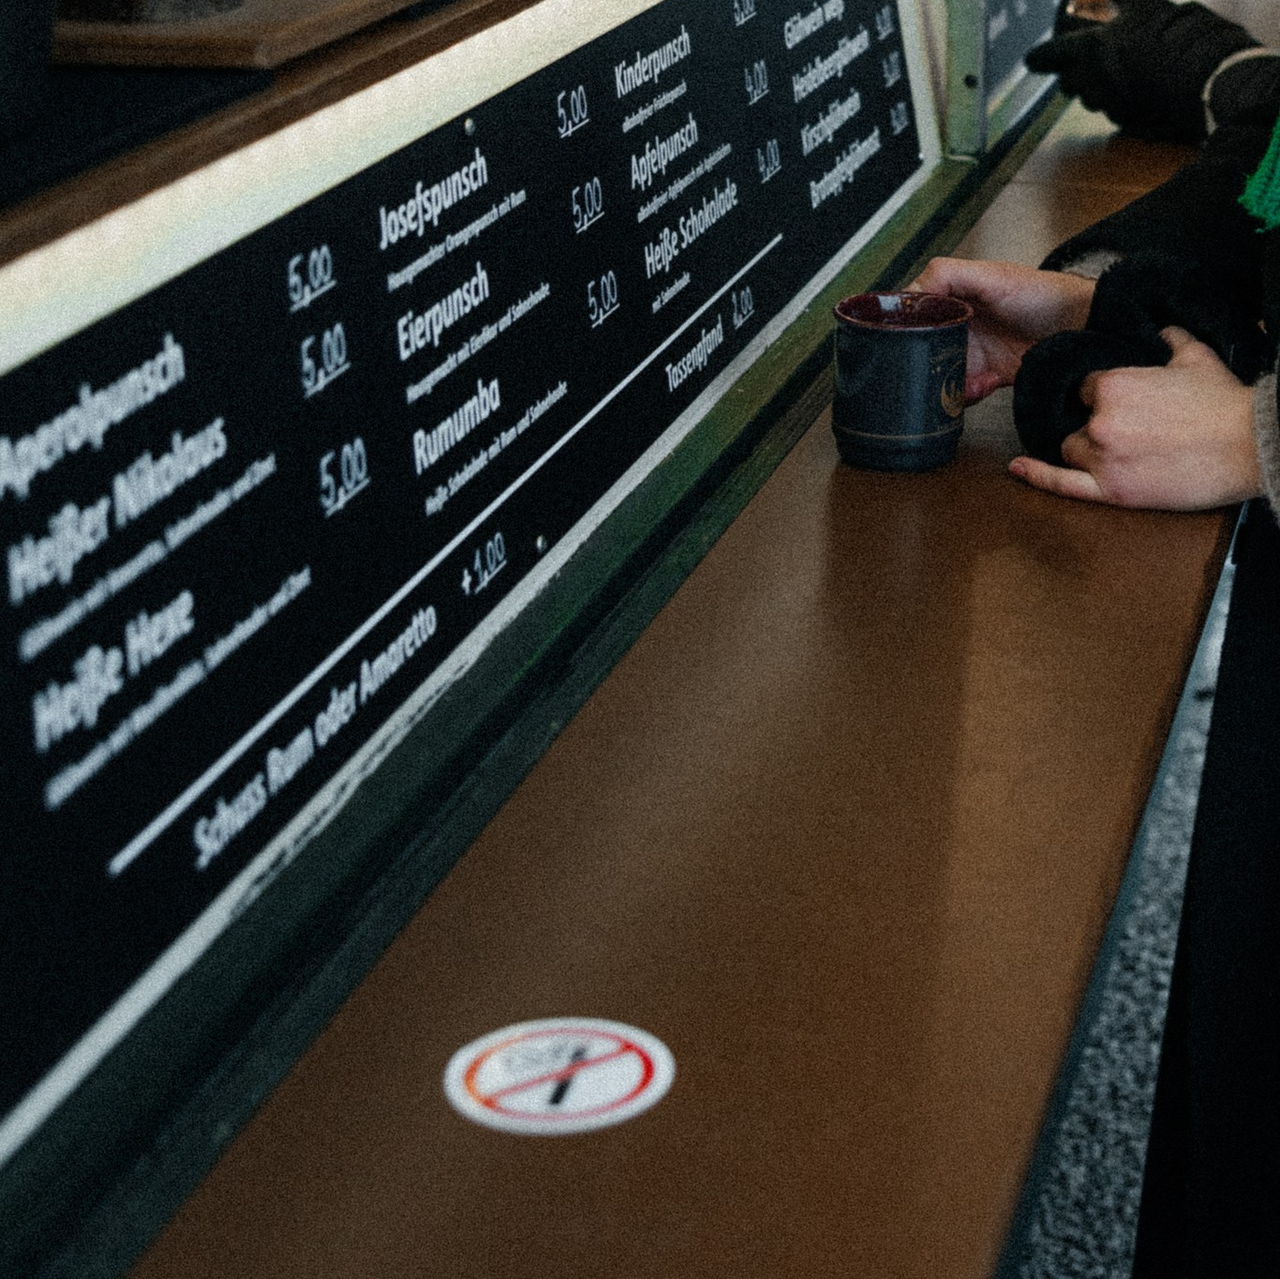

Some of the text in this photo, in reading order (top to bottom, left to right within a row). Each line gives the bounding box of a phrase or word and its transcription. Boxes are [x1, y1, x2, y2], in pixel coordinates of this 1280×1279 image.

[614, 23, 692, 99] Kinderpunsch
[557, 84, 588, 137] 5,00
[630, 112, 699, 191] Apfelpunsch
[379, 146, 489, 250] Josefspunsch
[571, 176, 603, 231] 5,00
[644, 177, 739, 279] Heiße Schokolade
[288, 244, 334, 311] 5,00
[397, 260, 490, 361] Eierpunsch
[587, 270, 618, 326] 5,00
[301, 321, 348, 395] 5,00
[665, 313, 724, 392] Tassenpfand
[413, 377, 501, 475] Rumumba
[8, 494, 111, 606] Heißer
[113, 415, 228, 528] Nikolaus
[320, 436, 369, 513] 5,00
[32, 644, 124, 755] Heiße
[266, 727, 316, 796] Rum
[314, 681, 358, 749] oder
[360, 604, 438, 705] Amaretto
[473, 531, 507, 593] 1,00
